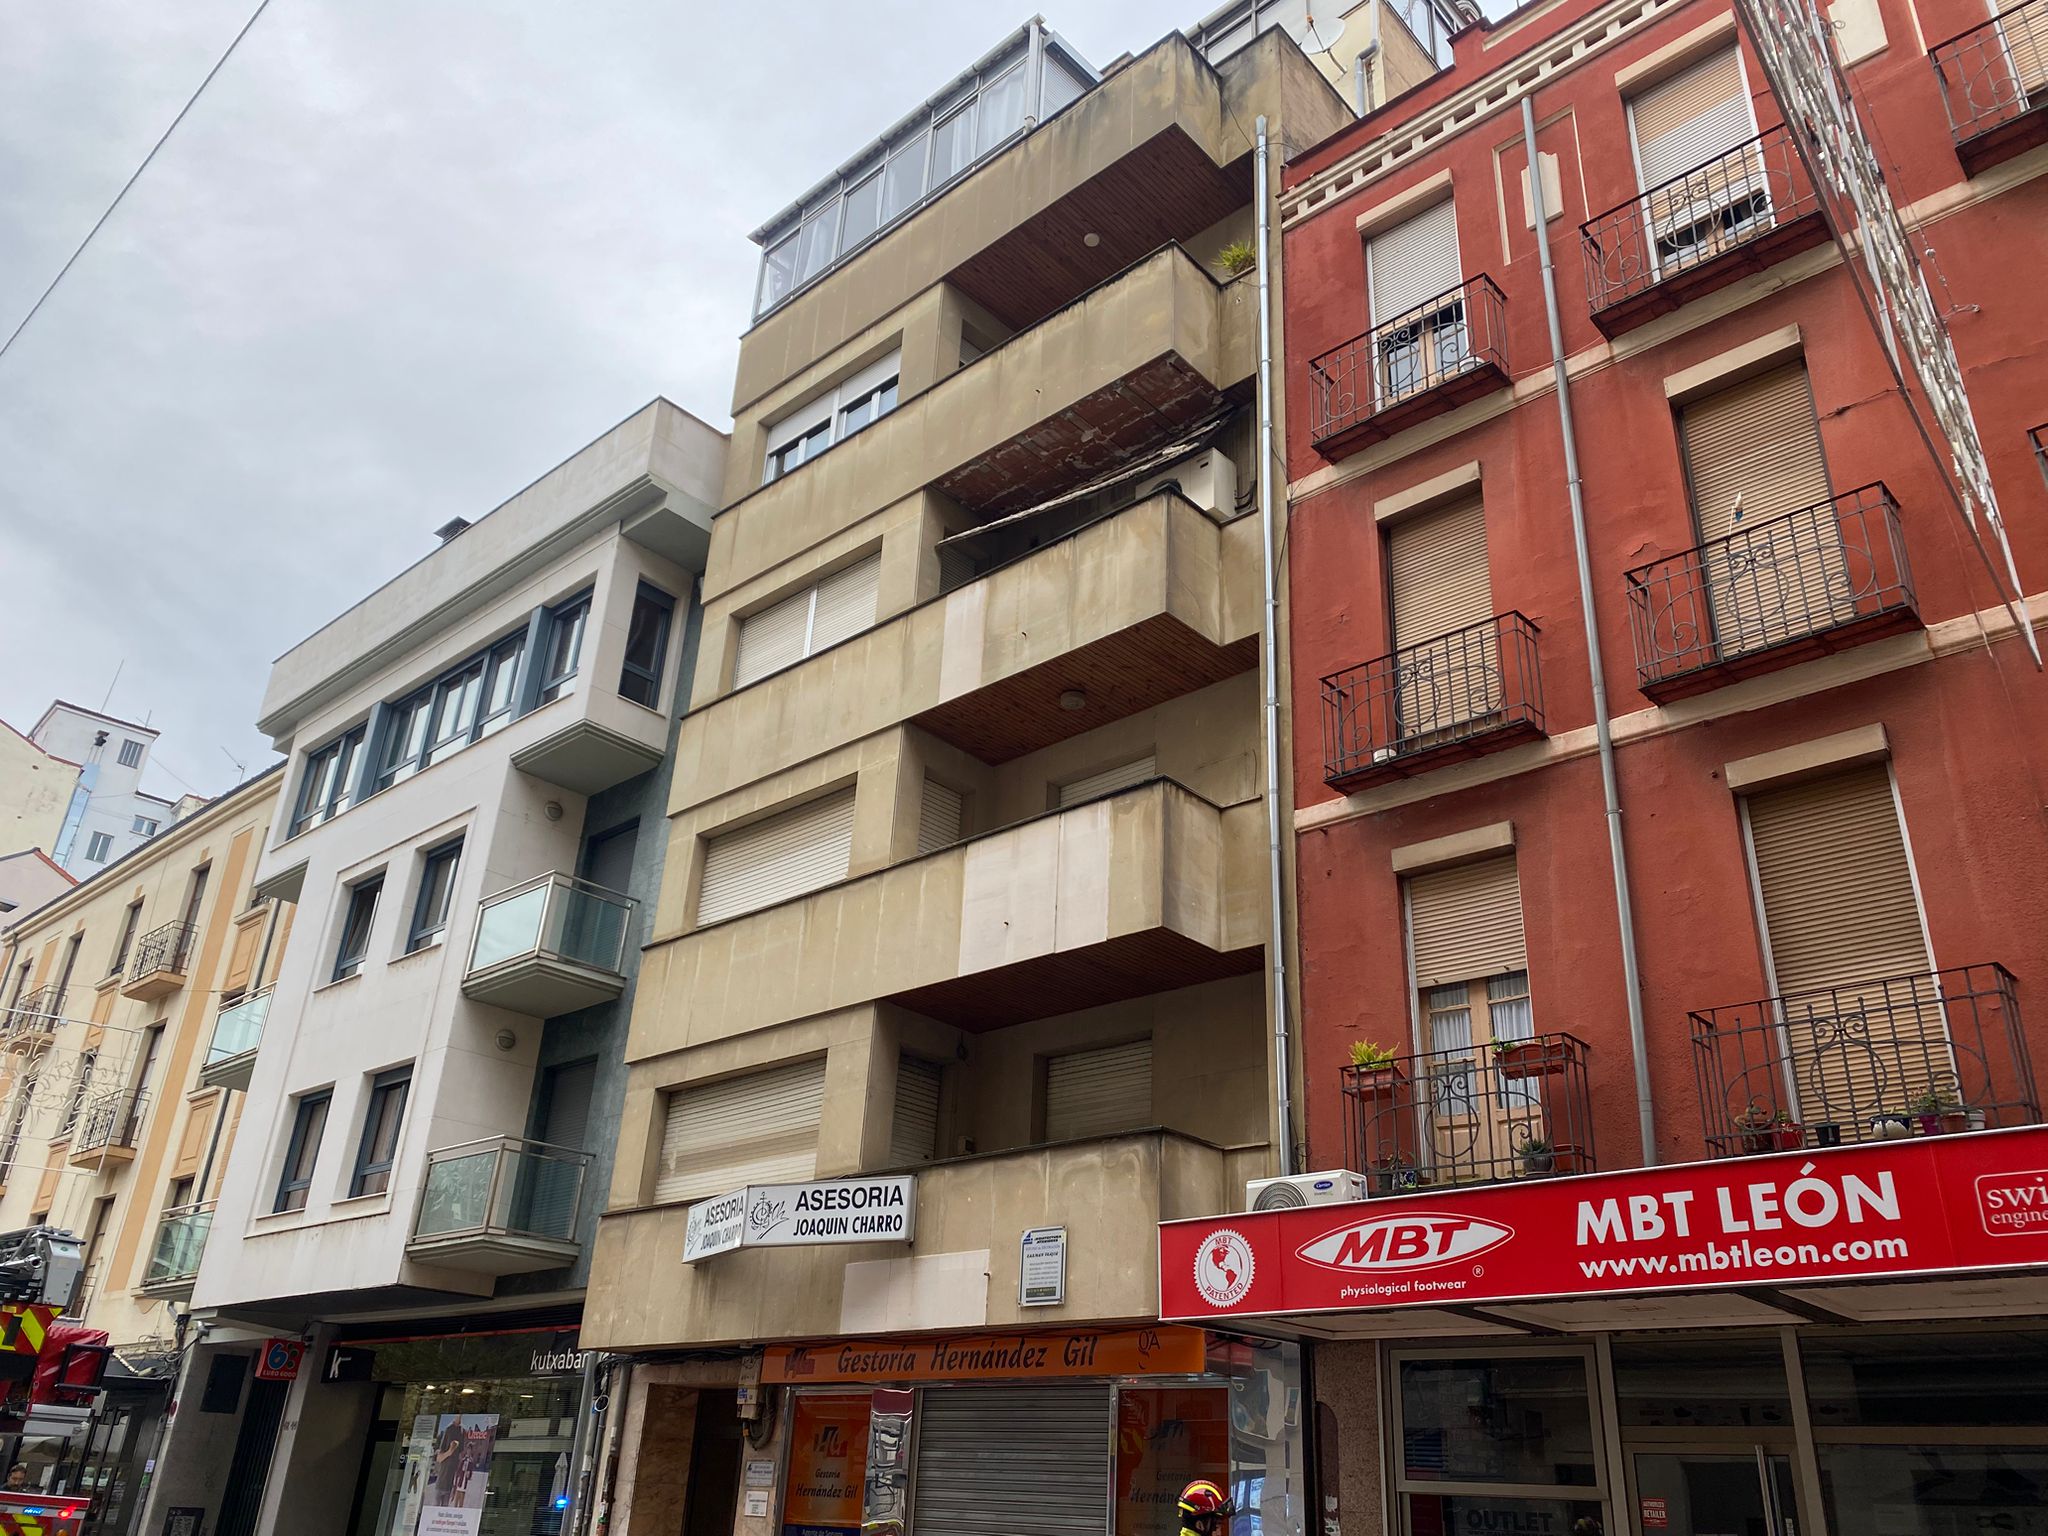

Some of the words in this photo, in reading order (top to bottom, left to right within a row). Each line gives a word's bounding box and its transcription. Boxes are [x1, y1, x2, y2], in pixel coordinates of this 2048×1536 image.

[795, 1185, 904, 1212] ASESORIA
[1576, 1190, 1695, 1246] MBT
[1716, 1161, 1901, 1234] LEÓN
[704, 1195, 744, 1228] ASESORIA
[793, 1217, 849, 1237] JOAQUIN
[852, 1214, 903, 1234] CHARRO
[700, 1230, 721, 1251] JOAQUIN
[1215, 1237, 1233, 1246] MBT
[1331, 1219, 1472, 1266] MBT
[1578, 1237, 1909, 1279] www.mbtleon.com
[1205, 1282, 1244, 1300] PATENTED
[1340, 1280, 1411, 1299] physiological
[1414, 1279, 1467, 1294] footwear
[839, 1344, 916, 1374] Gestoría
[930, 1335, 1049, 1371] Hernández
[1063, 1335, 1098, 1367] Gil
[280, 1370, 297, 1378] 6000
[795, 1482, 843, 1498] Hernández
[844, 1485, 858, 1499] Gil
[1466, 1509, 1553, 1531] OUTLET
